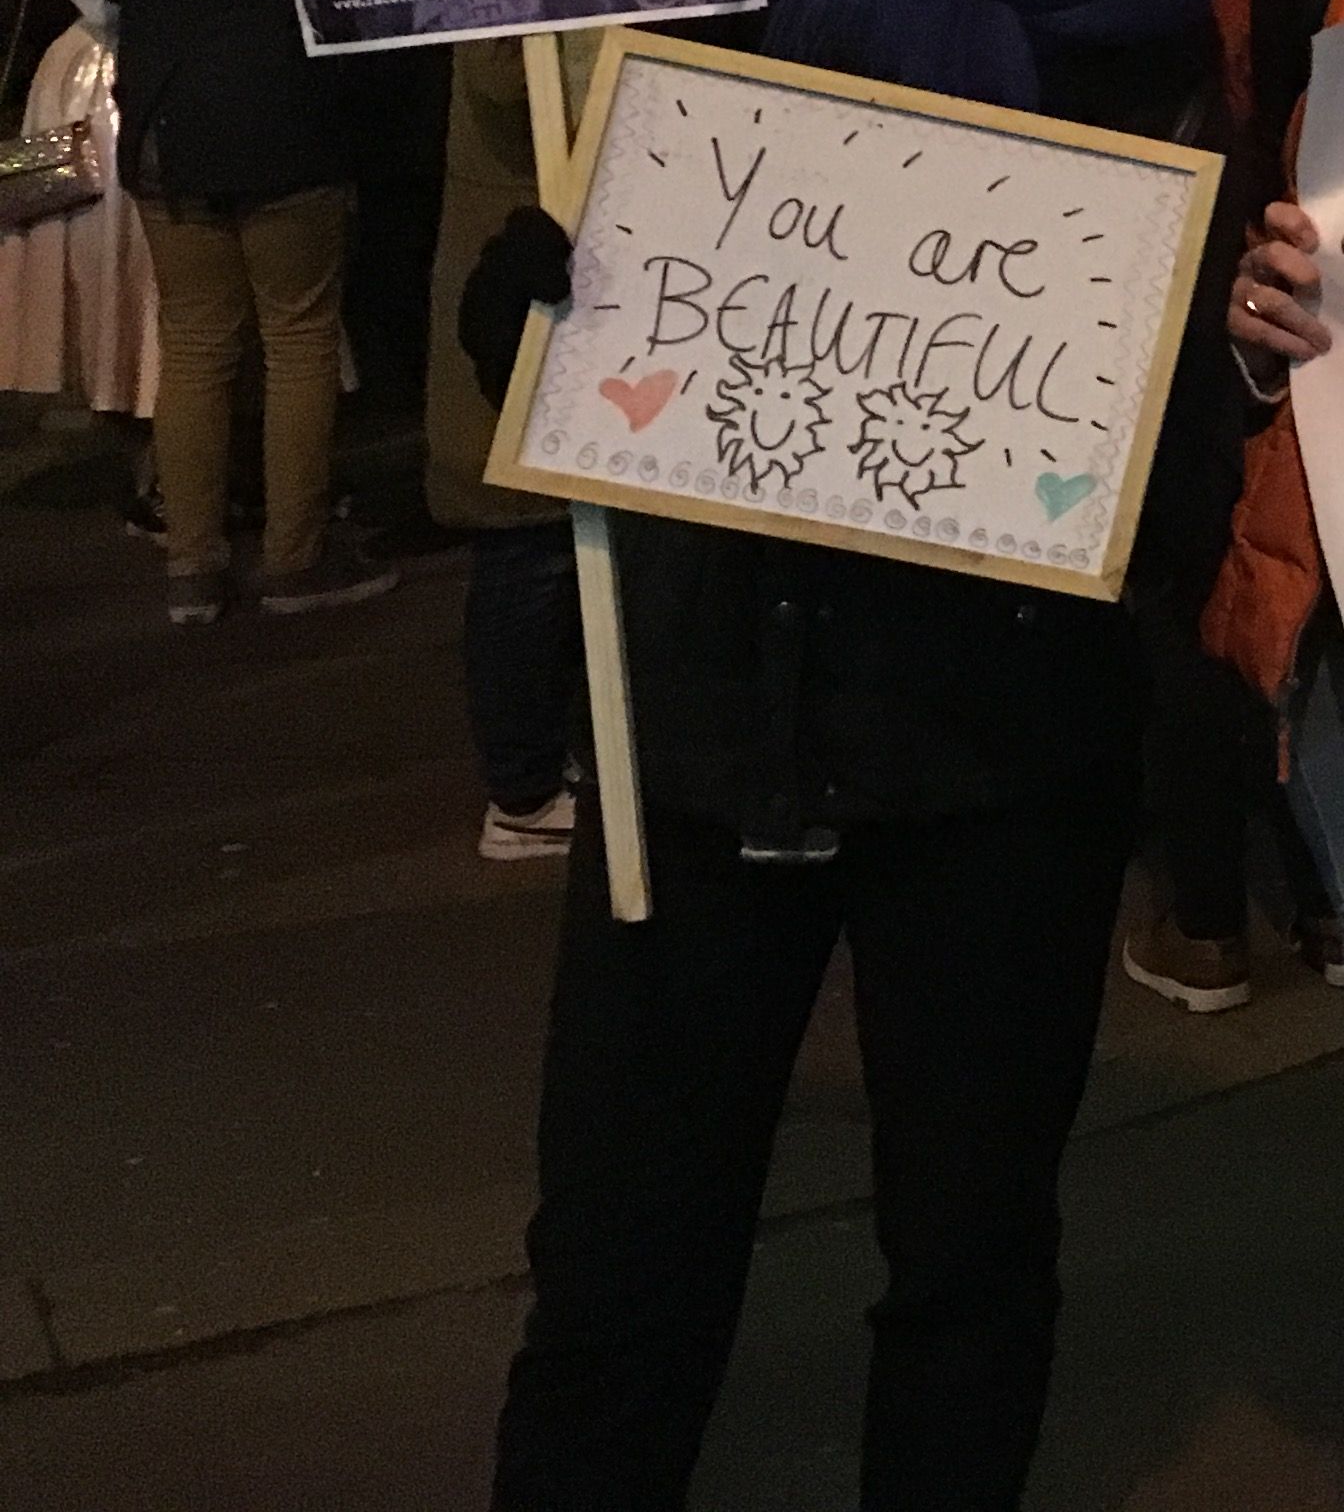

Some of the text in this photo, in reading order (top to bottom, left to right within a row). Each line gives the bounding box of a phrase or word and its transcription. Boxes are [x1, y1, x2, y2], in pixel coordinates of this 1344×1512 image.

[711, 136, 1044, 298] You are
[643, 256, 1079, 423] BEAUTIFUL
